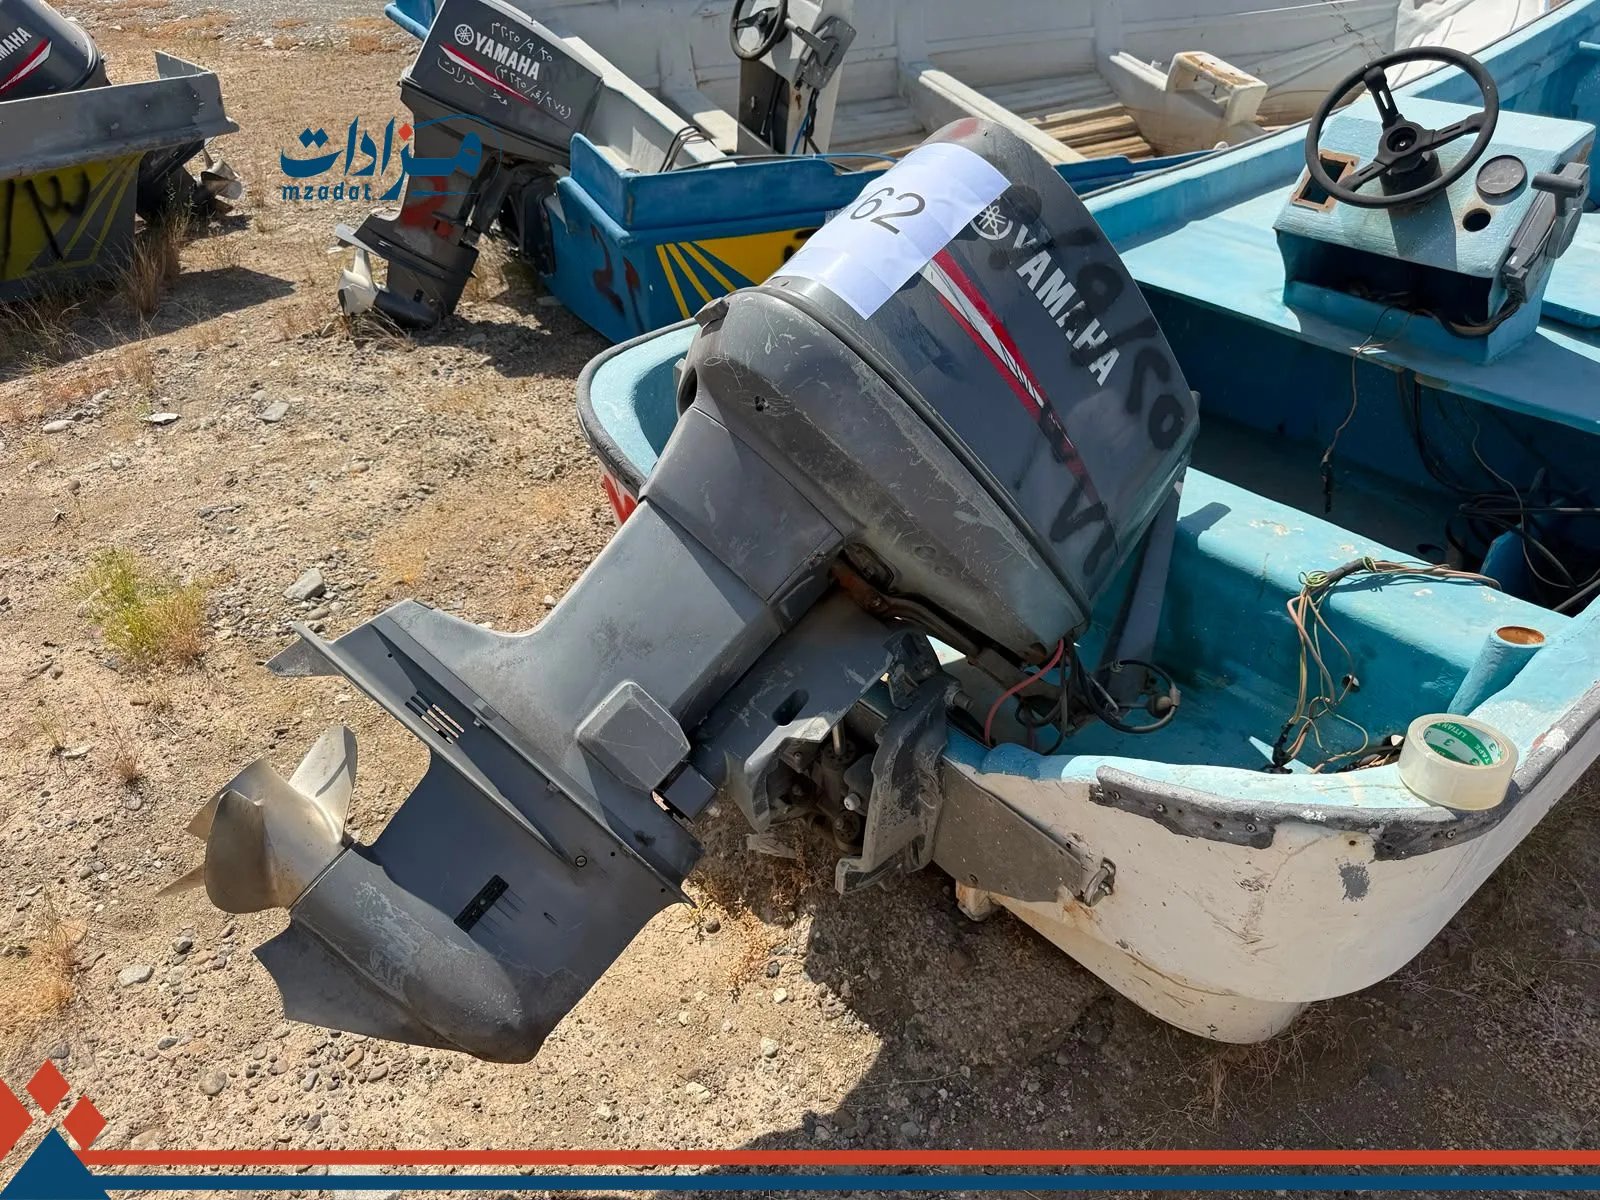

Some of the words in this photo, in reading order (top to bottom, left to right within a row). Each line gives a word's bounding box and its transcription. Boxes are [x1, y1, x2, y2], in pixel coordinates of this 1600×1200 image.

[0, 27, 32, 61] MAHA
[474, 32, 540, 80] YAMAHA
[850, 187, 926, 235] 62
